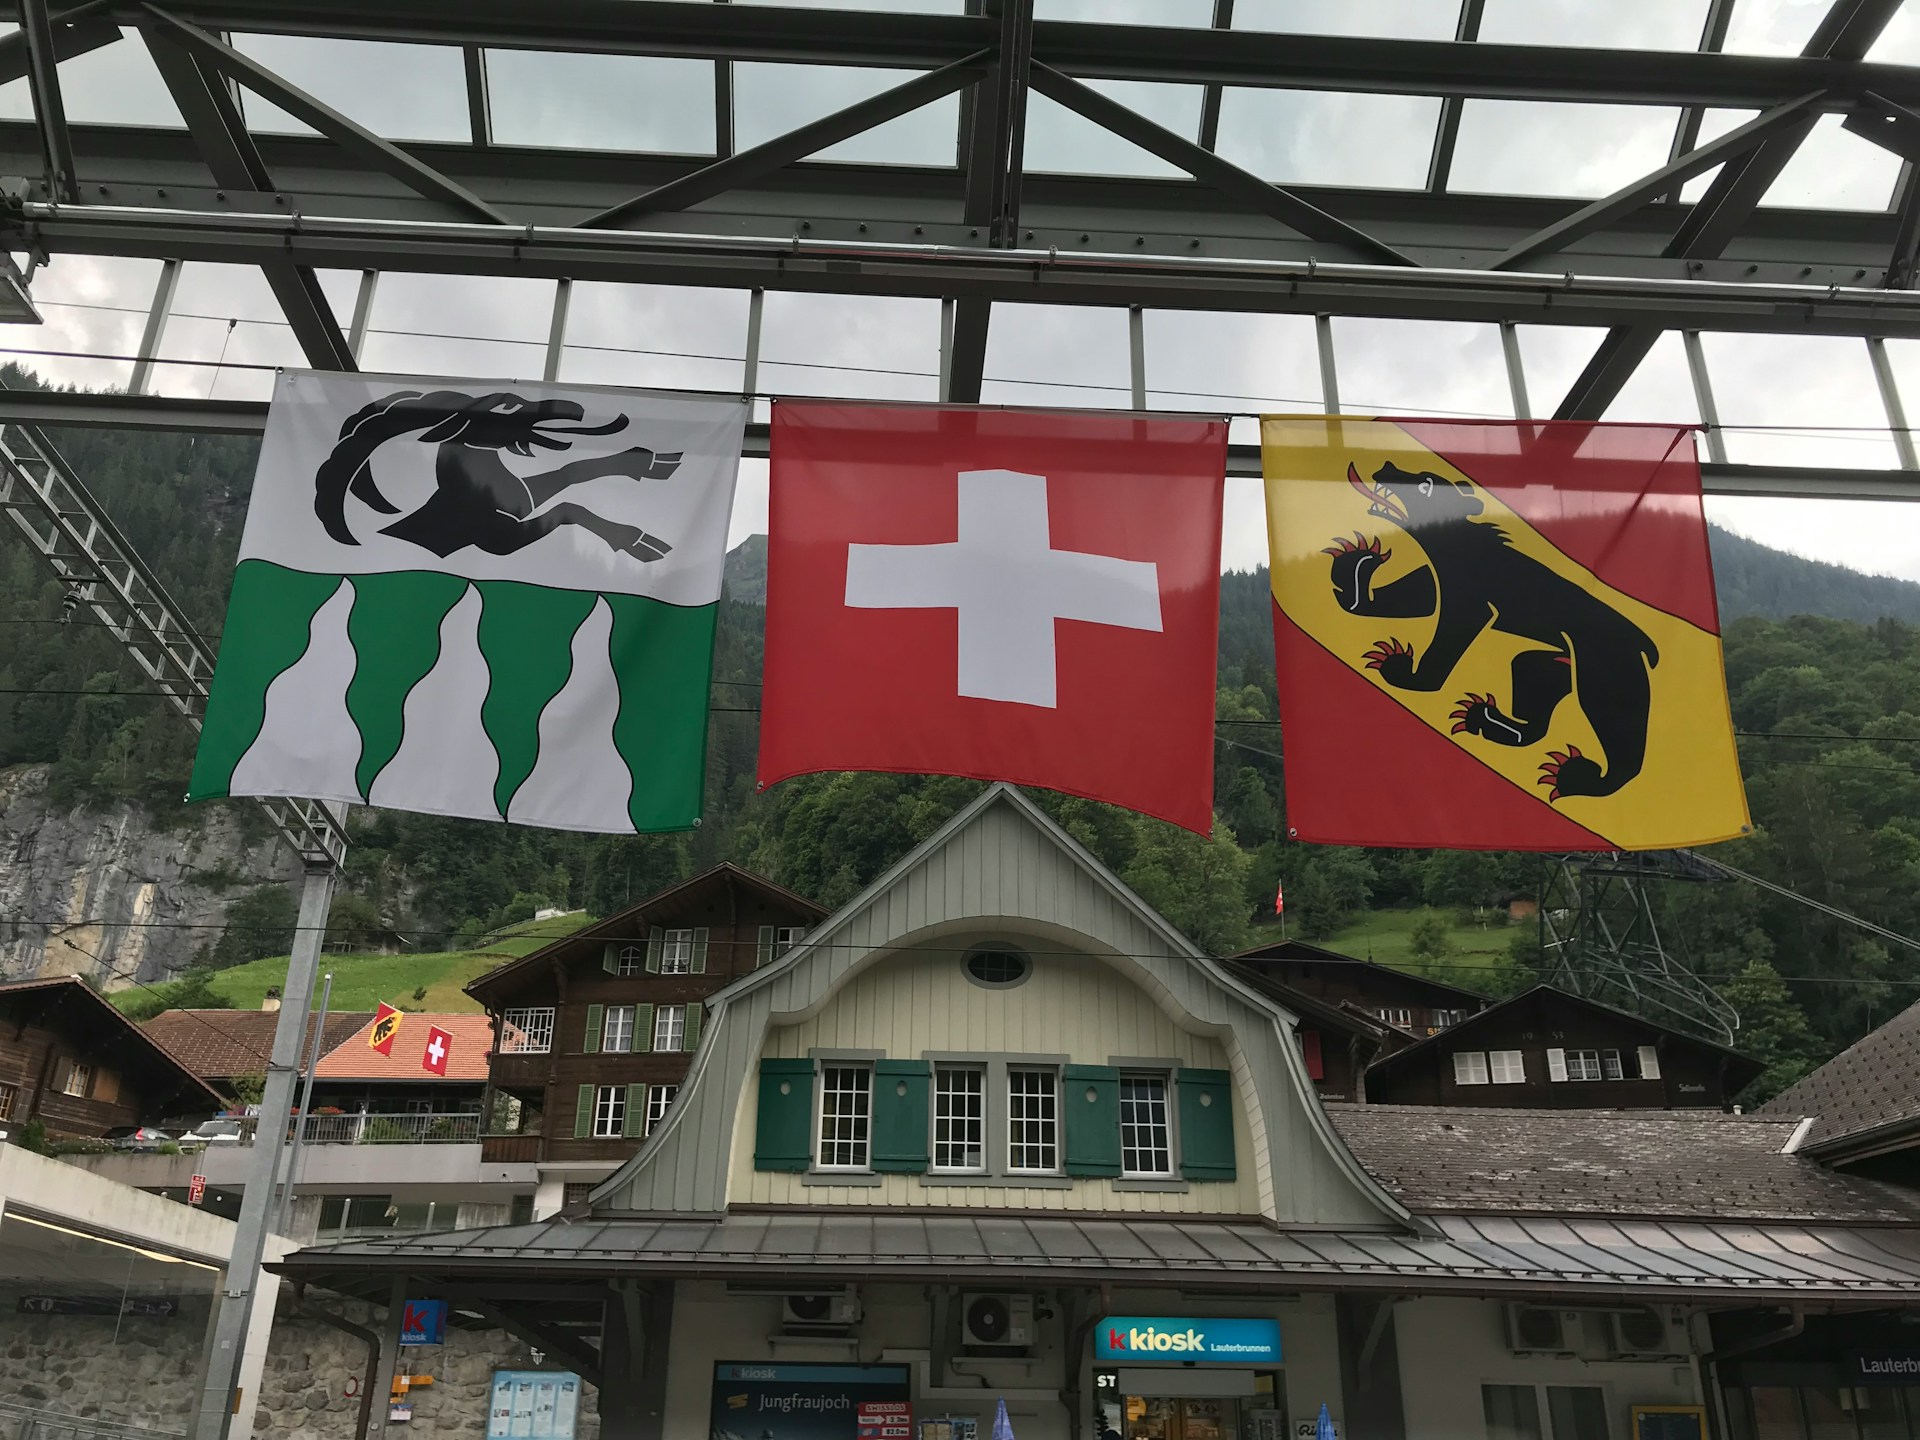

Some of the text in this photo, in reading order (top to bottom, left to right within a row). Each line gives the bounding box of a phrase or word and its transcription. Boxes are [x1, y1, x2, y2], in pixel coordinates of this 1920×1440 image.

[402, 1333, 427, 1342] kiosk
[1109, 1326, 1272, 1353] k kiosk Lauterbrunnen
[741, 1368, 776, 1379] kiosk
[1096, 1374, 1116, 1388] ST
[758, 1394, 850, 1412] Jungfraujoch
